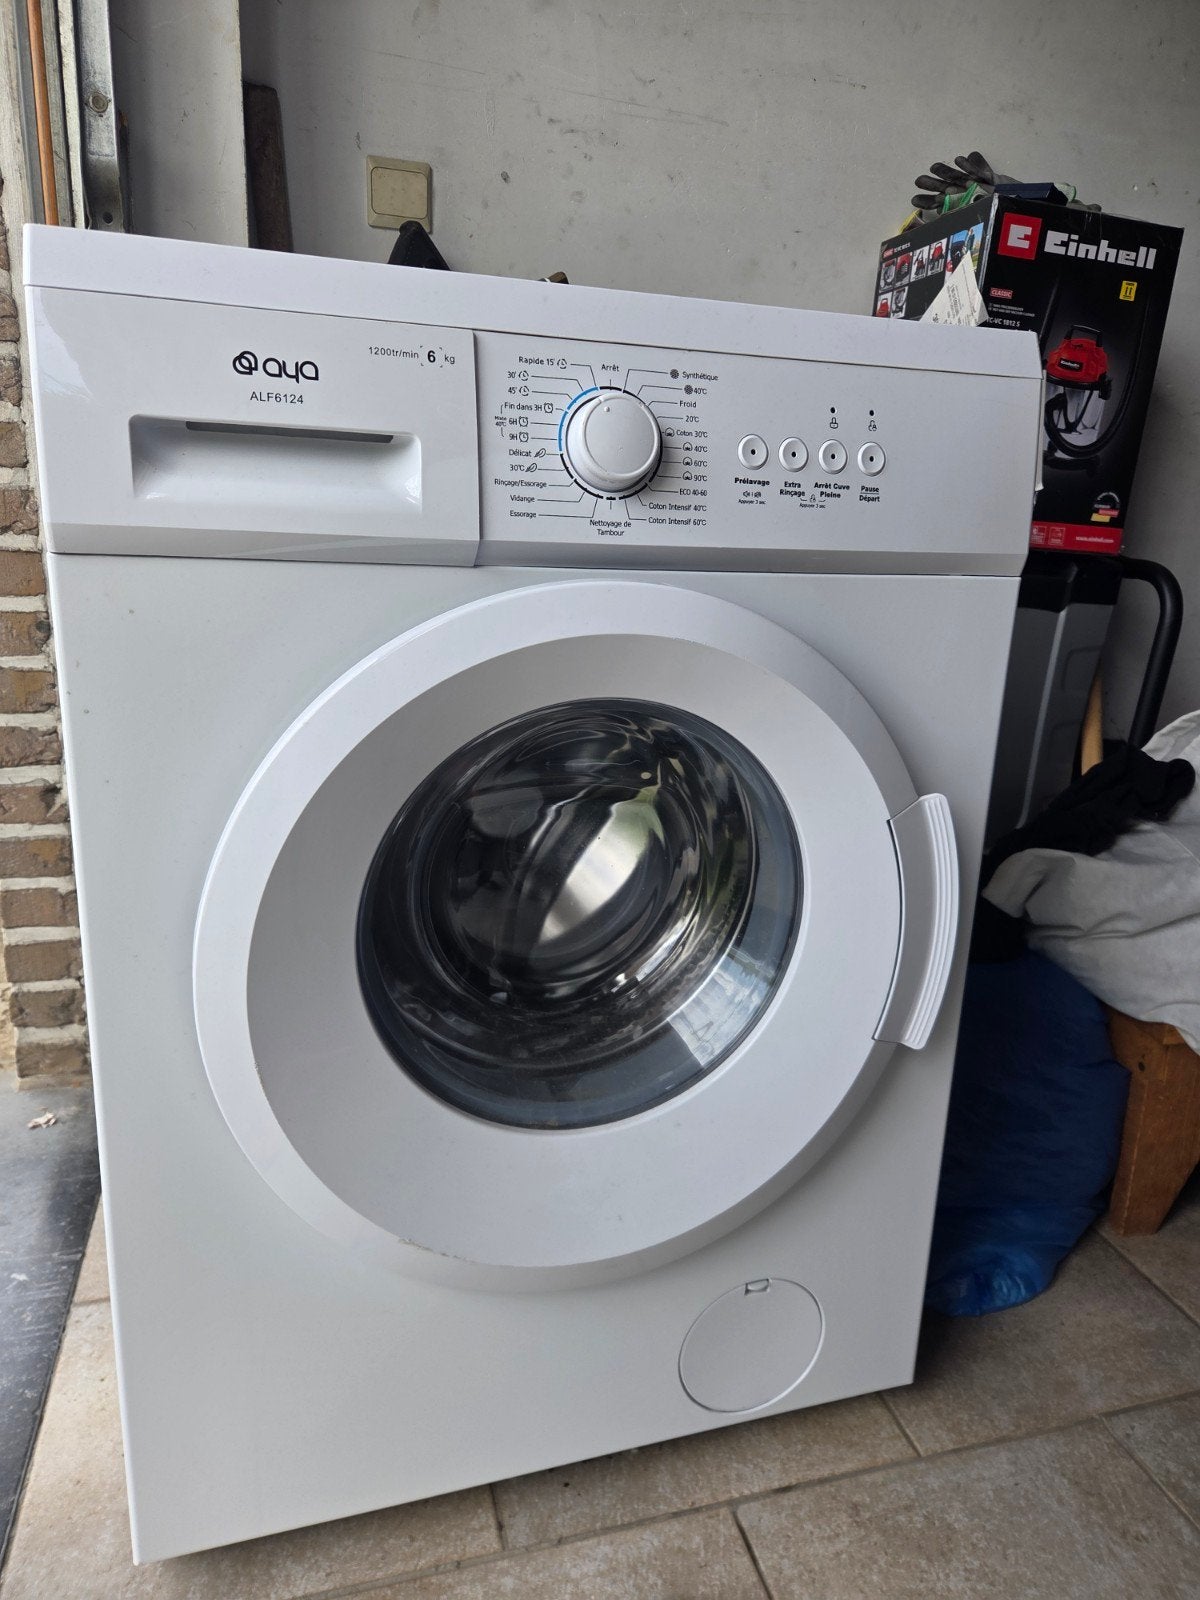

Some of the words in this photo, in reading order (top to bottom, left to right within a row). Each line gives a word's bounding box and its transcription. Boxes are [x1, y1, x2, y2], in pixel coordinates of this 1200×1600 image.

[1044, 230, 1157, 270] Einhell
[368, 346, 419, 359] 1200tr/min
[427, 350, 436, 363] 6
[444, 354, 455, 364] kg
[518, 356, 544, 365] Rapide
[262, 357, 319, 383] aya
[601, 363, 620, 372] Arrêt
[682, 371, 719, 381] Synthétique
[250, 391, 304, 404] ALF6124
[504, 402, 515, 410] Fin
[516, 403, 532, 411] dans
[679, 400, 697, 408] Froid
[508, 418, 518, 426] 6H
[508, 433, 518, 441] 9H
[676, 429, 693, 437] Coton
[508, 448, 532, 457] Délicat
[494, 478, 547, 489] Rinçage/Essorage
[734, 477, 770, 487] Prélavage
[783, 481, 801, 489] Extra
[813, 481, 832, 490] Arrêt
[833, 483, 850, 491] Cuve
[679, 488, 691, 496] ECO
[692, 488, 708, 497] 40-60
[779, 489, 806, 498] Rinçage
[861, 485, 880, 493] Pause
[510, 494, 535, 503] Vidange
[820, 490, 841, 499] Pleine
[859, 494, 880, 503] Départ
[648, 502, 667, 510] Coton
[668, 503, 692, 511] Intensif
[509, 510, 537, 518] Essorage
[589, 519, 622, 528] Nettoyage
[648, 516, 667, 524] Coton
[668, 517, 692, 525] Intensif
